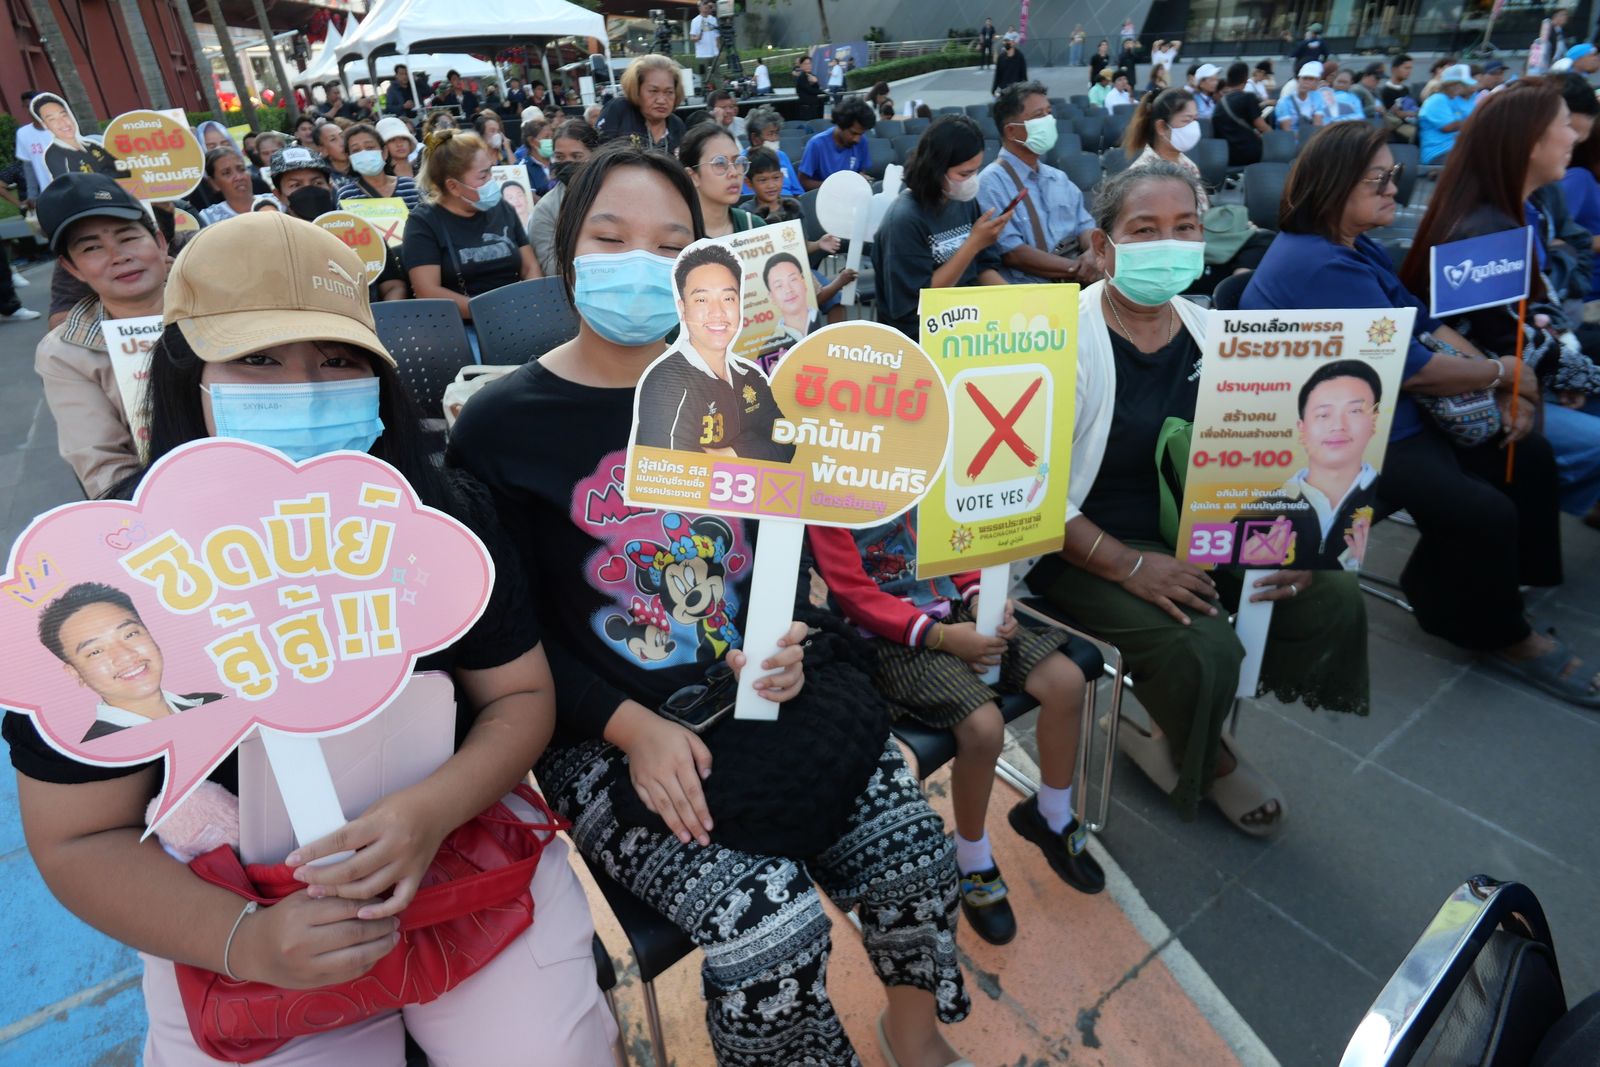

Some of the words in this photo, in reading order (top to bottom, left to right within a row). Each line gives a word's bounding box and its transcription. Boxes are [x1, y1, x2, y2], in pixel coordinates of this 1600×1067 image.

[312, 276, 355, 301] PUMA
[926, 318, 939, 334] 8
[941, 307, 979, 328] กุมภา
[1224, 318, 1344, 333] โปรดเลือกพรรค
[942, 320, 1066, 358] กาเห็นชอบ
[1218, 335, 1344, 359] ประชาชาติ
[827, 343, 904, 370] หาดใหญ่
[794, 364, 933, 422] ซิดนีย์
[1223, 408, 1276, 423] สร้างคน
[773, 417, 885, 454] อภินันท์
[637, 456, 684, 474] ผู้สมัคร
[1192, 449, 1293, 469] 0-10-100
[709, 470, 756, 504] 33
[811, 455, 927, 495] พัฒนศิริ
[956, 493, 994, 512] VOTE
[1000, 488, 1023, 506] YES
[119, 482, 402, 614] ซิดนีย์
[1190, 530, 1233, 556] 33
